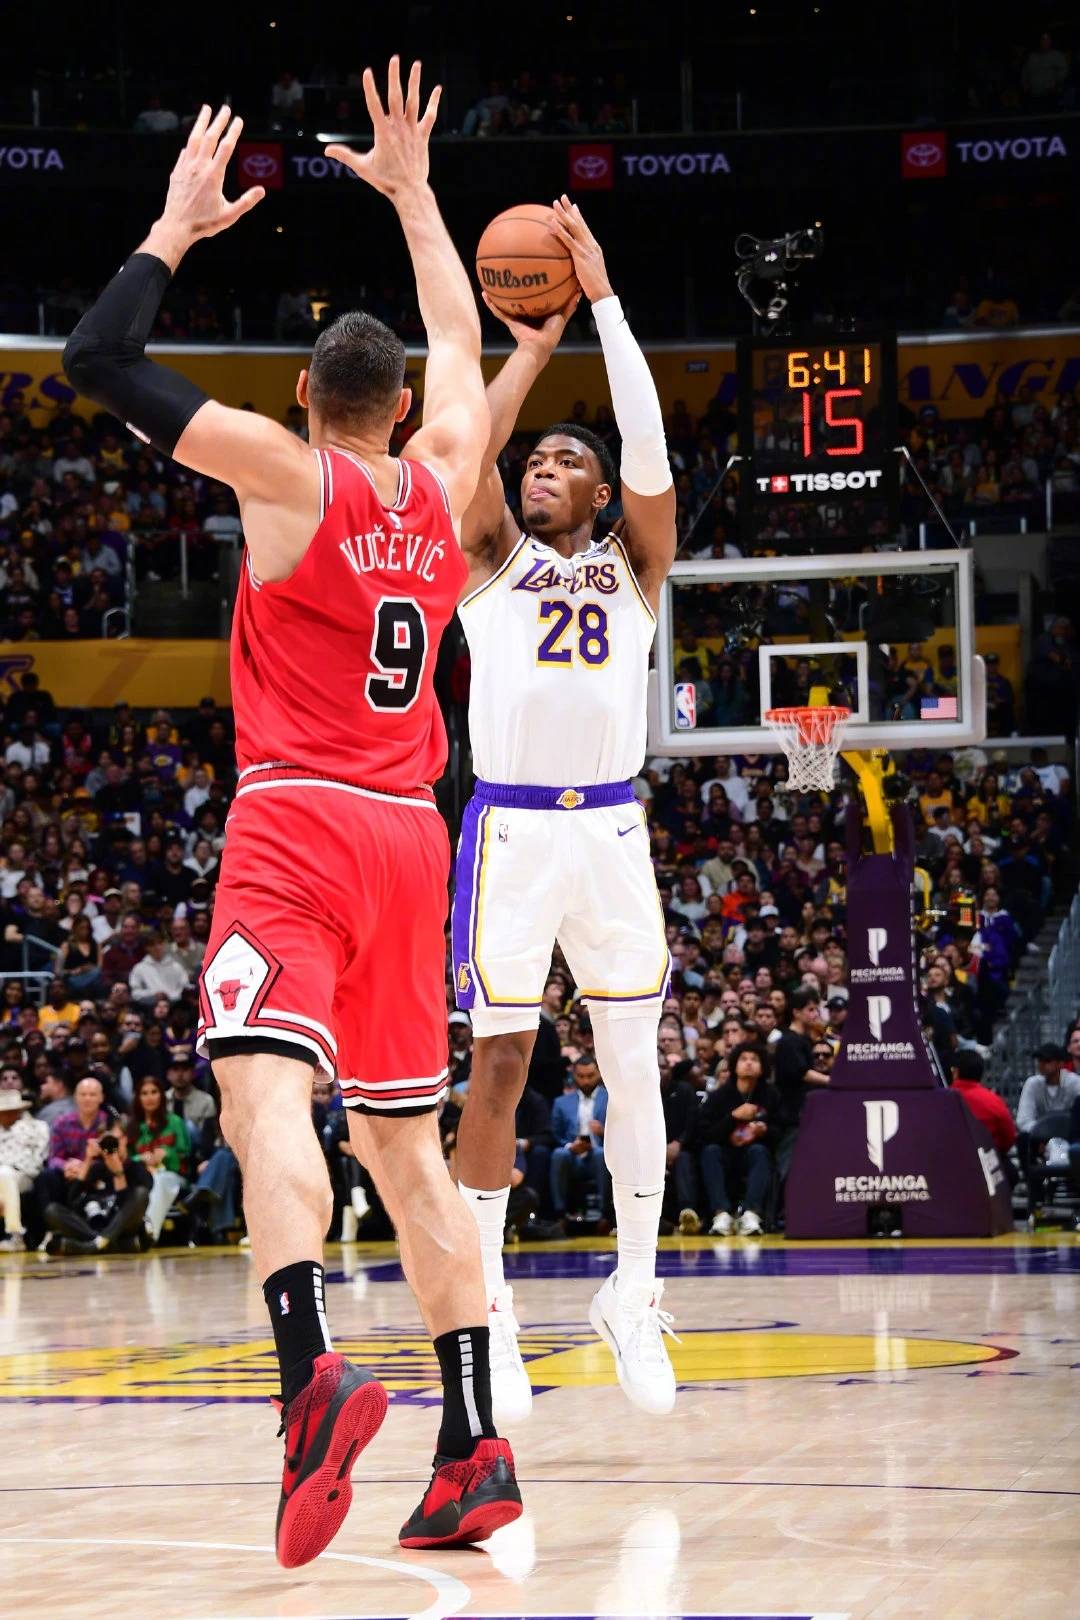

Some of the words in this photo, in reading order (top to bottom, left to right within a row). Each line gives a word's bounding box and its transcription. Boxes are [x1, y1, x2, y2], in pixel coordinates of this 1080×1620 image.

[956, 136, 1067, 162] TOYOTA
[623, 153, 731, 176] TOYOTA
[480, 266, 549, 289] Wilson
[787, 348, 871, 389] 6:41
[802, 388, 864, 458] 15
[790, 469, 883, 493] TISSOT
[338, 523, 446, 583] VUČEVIĆ
[536, 599, 612, 671] 28
[364, 595, 429, 714] 9
[850, 966, 905, 978] PECHANGA
[846, 1042, 914, 1054] PECHANGA
[834, 1175, 928, 1192] PECHANGA
[835, 1191, 881, 1202] RESORT
[885, 1190, 930, 1202] CASINO
